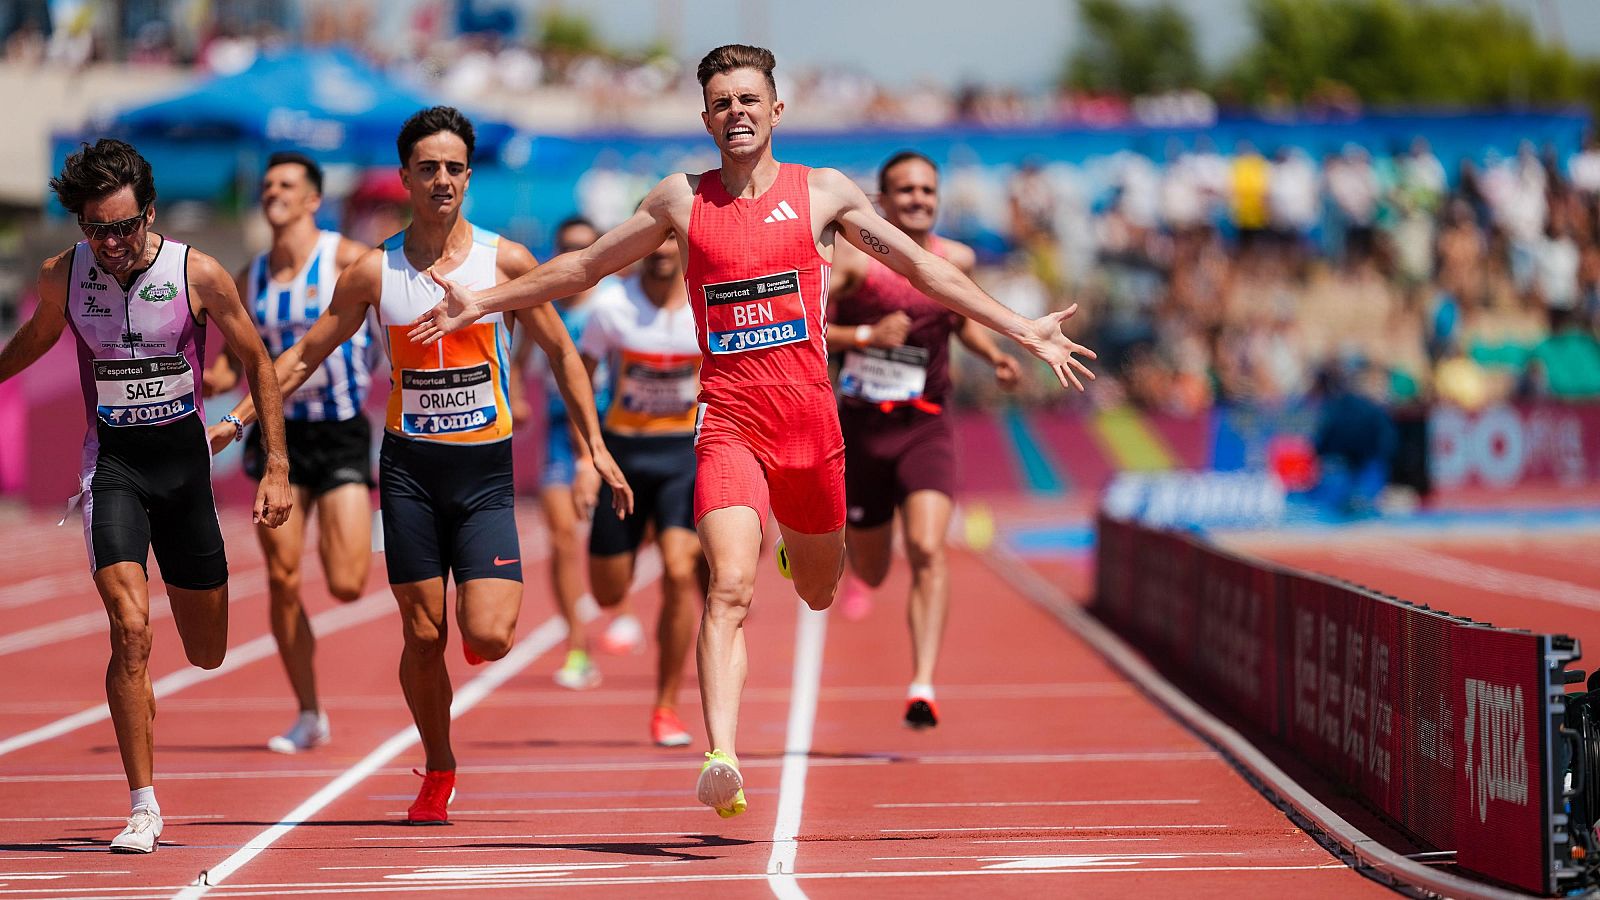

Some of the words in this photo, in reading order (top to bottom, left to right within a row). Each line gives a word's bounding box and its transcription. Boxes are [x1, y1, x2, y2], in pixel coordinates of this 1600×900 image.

[80, 281, 108, 291] VIATOR
[715, 288, 750, 300] esportcat
[733, 301, 774, 327] BEN
[735, 324, 797, 349] Joma
[107, 367, 143, 376] esportcat
[126, 380, 166, 400] SAEZ
[419, 389, 476, 409] ORIACH
[126, 399, 185, 424] Joma
[429, 410, 488, 433] Joma
